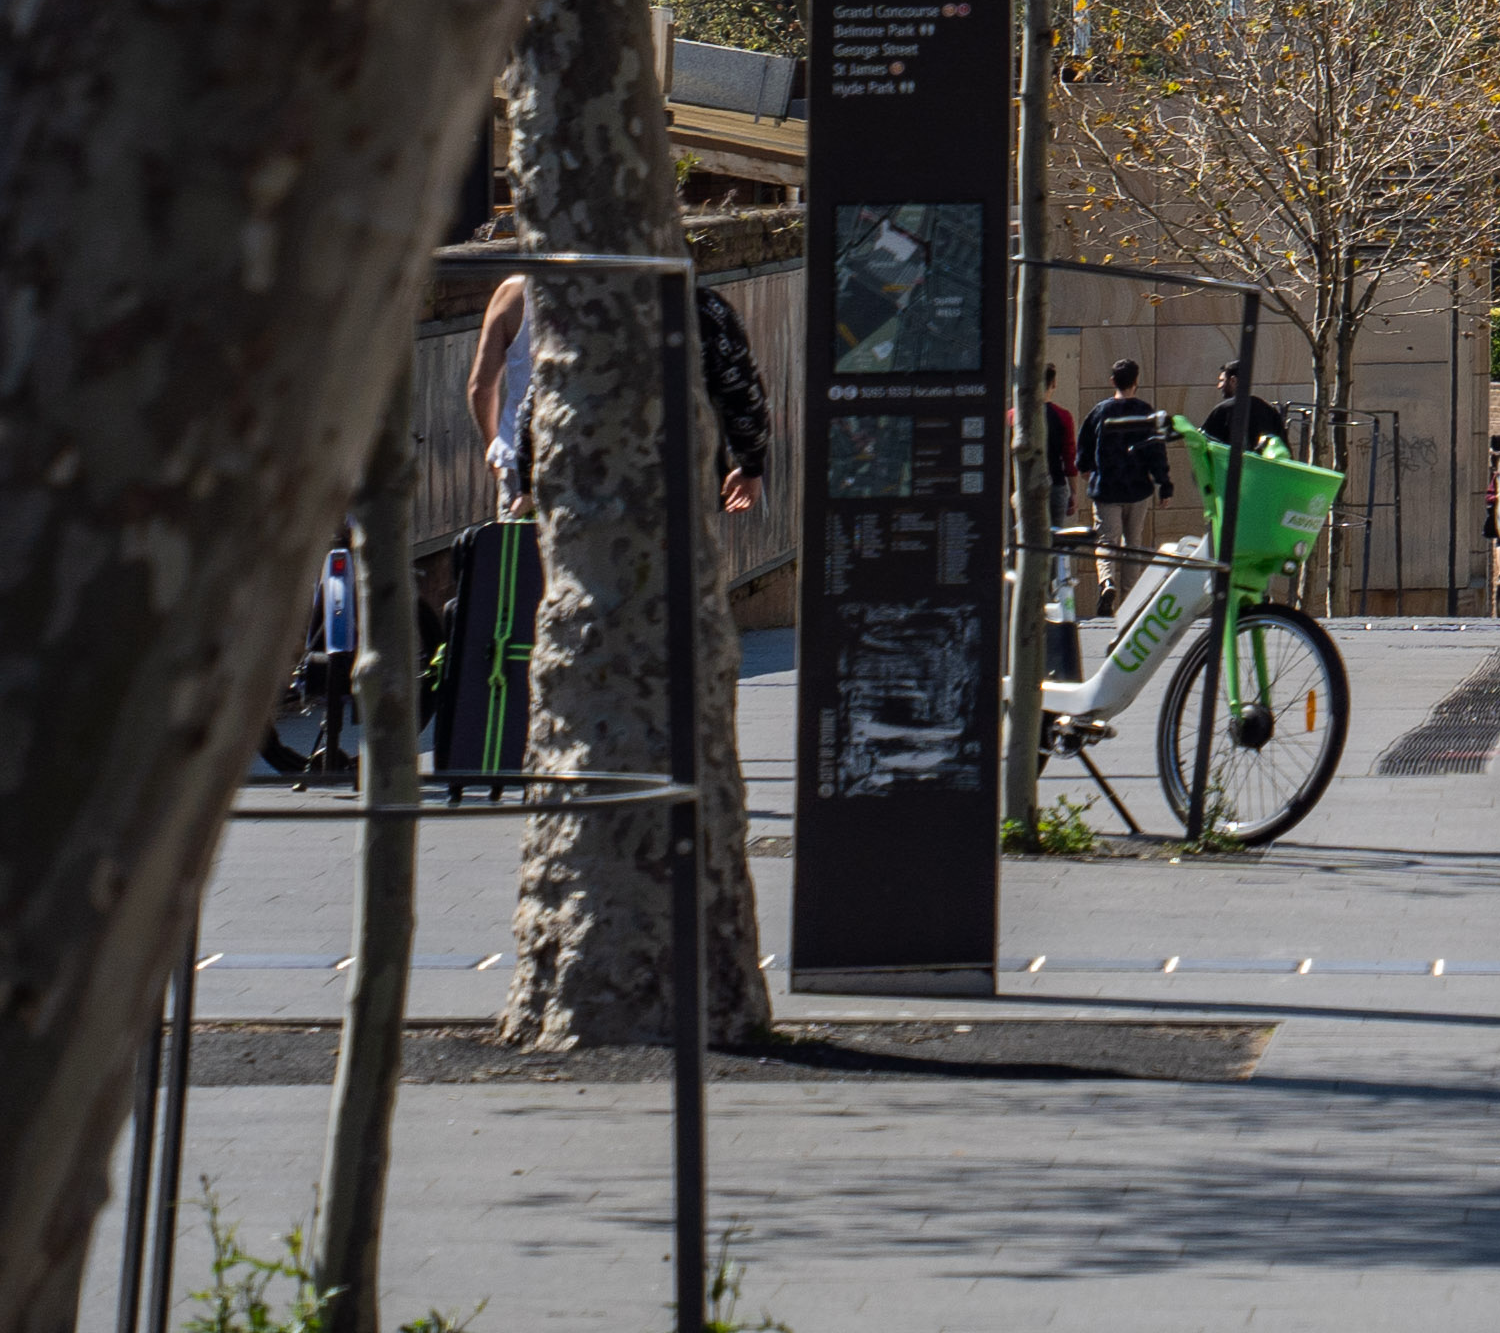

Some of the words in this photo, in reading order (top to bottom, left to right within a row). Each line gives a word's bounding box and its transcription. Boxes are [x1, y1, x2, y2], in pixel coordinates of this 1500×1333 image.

[833, 5, 873, 19] Grand
[875, 5, 940, 19] Concourse
[833, 24, 885, 37] Belmore
[888, 23, 915, 36] Park
[833, 43, 880, 60] George
[882, 42, 919, 56] Street
[832, 82, 865, 98] Hyde
[868, 81, 896, 94] Park
